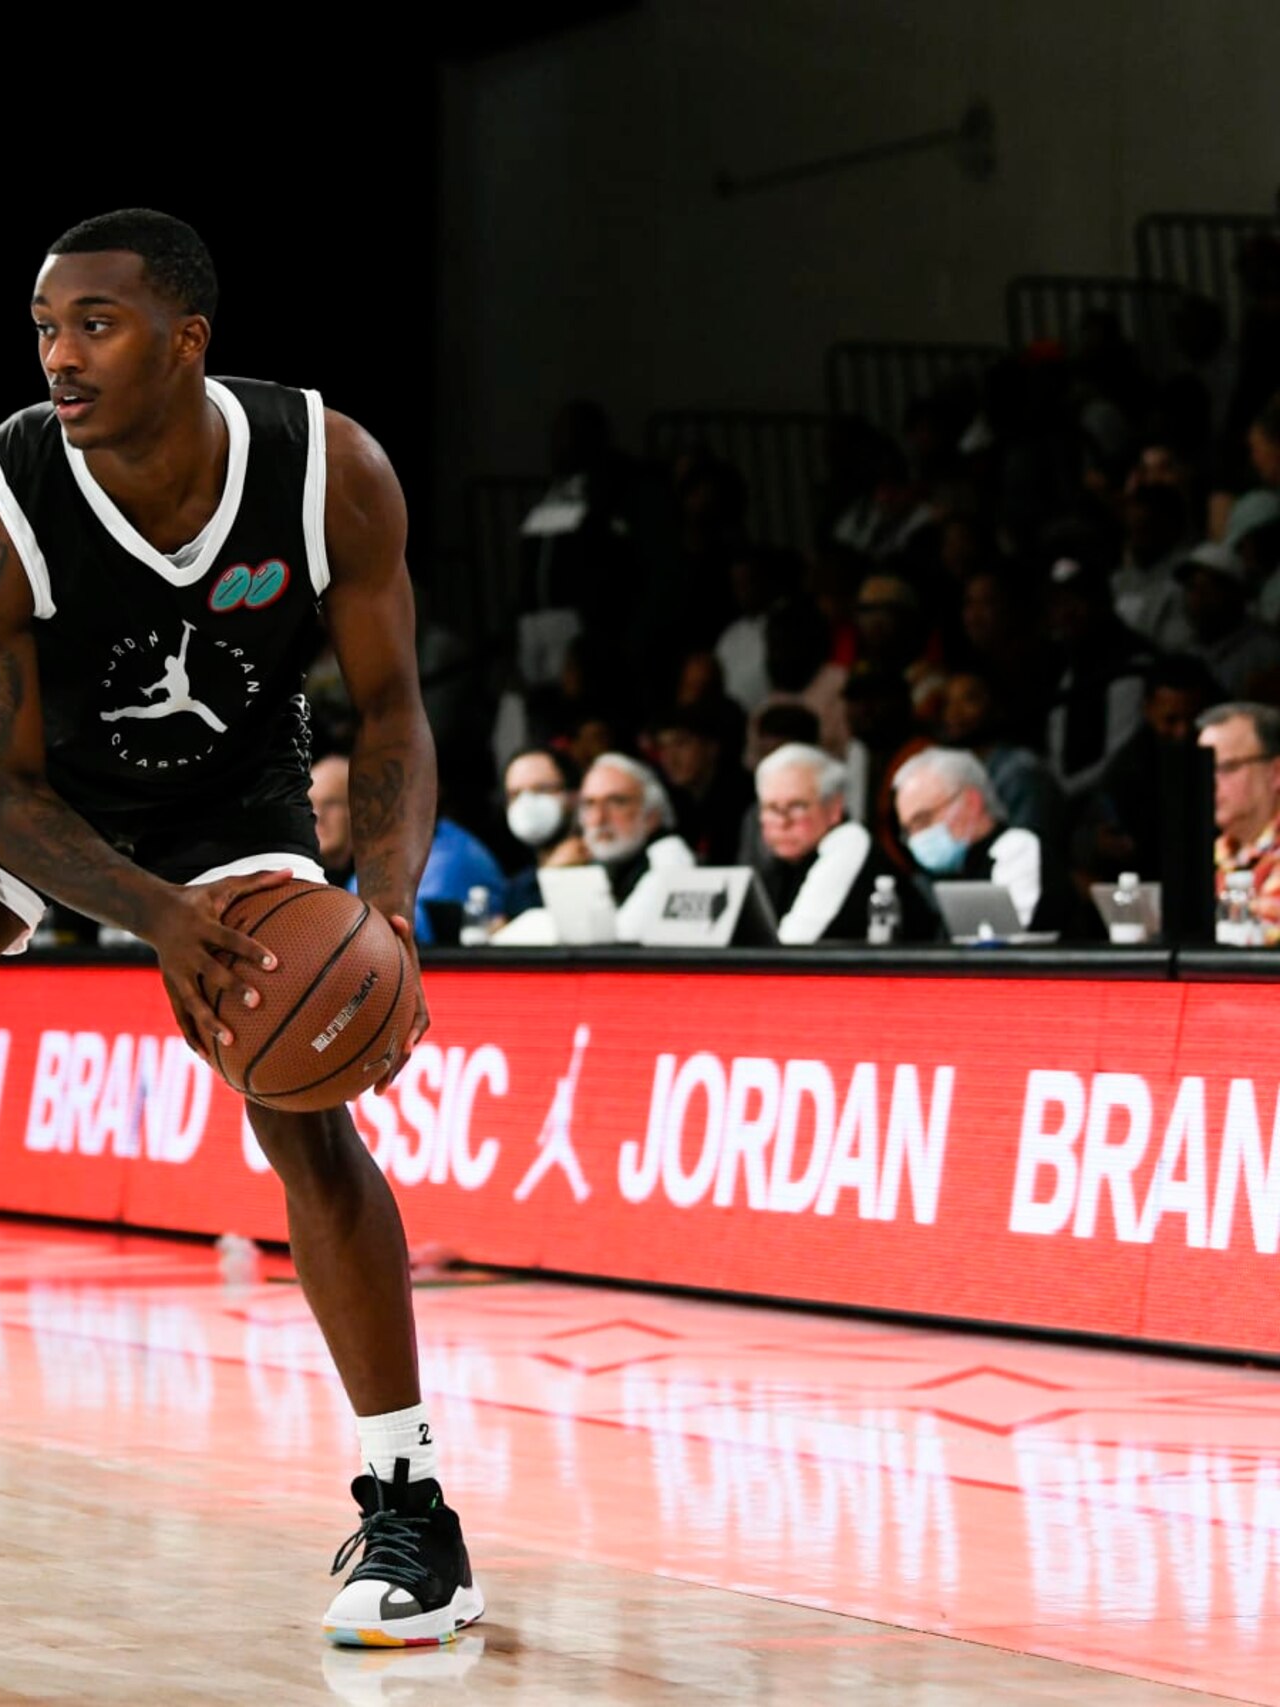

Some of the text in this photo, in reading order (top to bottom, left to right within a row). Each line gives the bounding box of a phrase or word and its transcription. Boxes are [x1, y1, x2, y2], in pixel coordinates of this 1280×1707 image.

[101, 630, 260, 708] JORDN BRAN
[24, 1029, 212, 1164] BRAND
[618, 1051, 1280, 1255] JORDAN BRAN
[418, 1423, 433, 1446] 2
